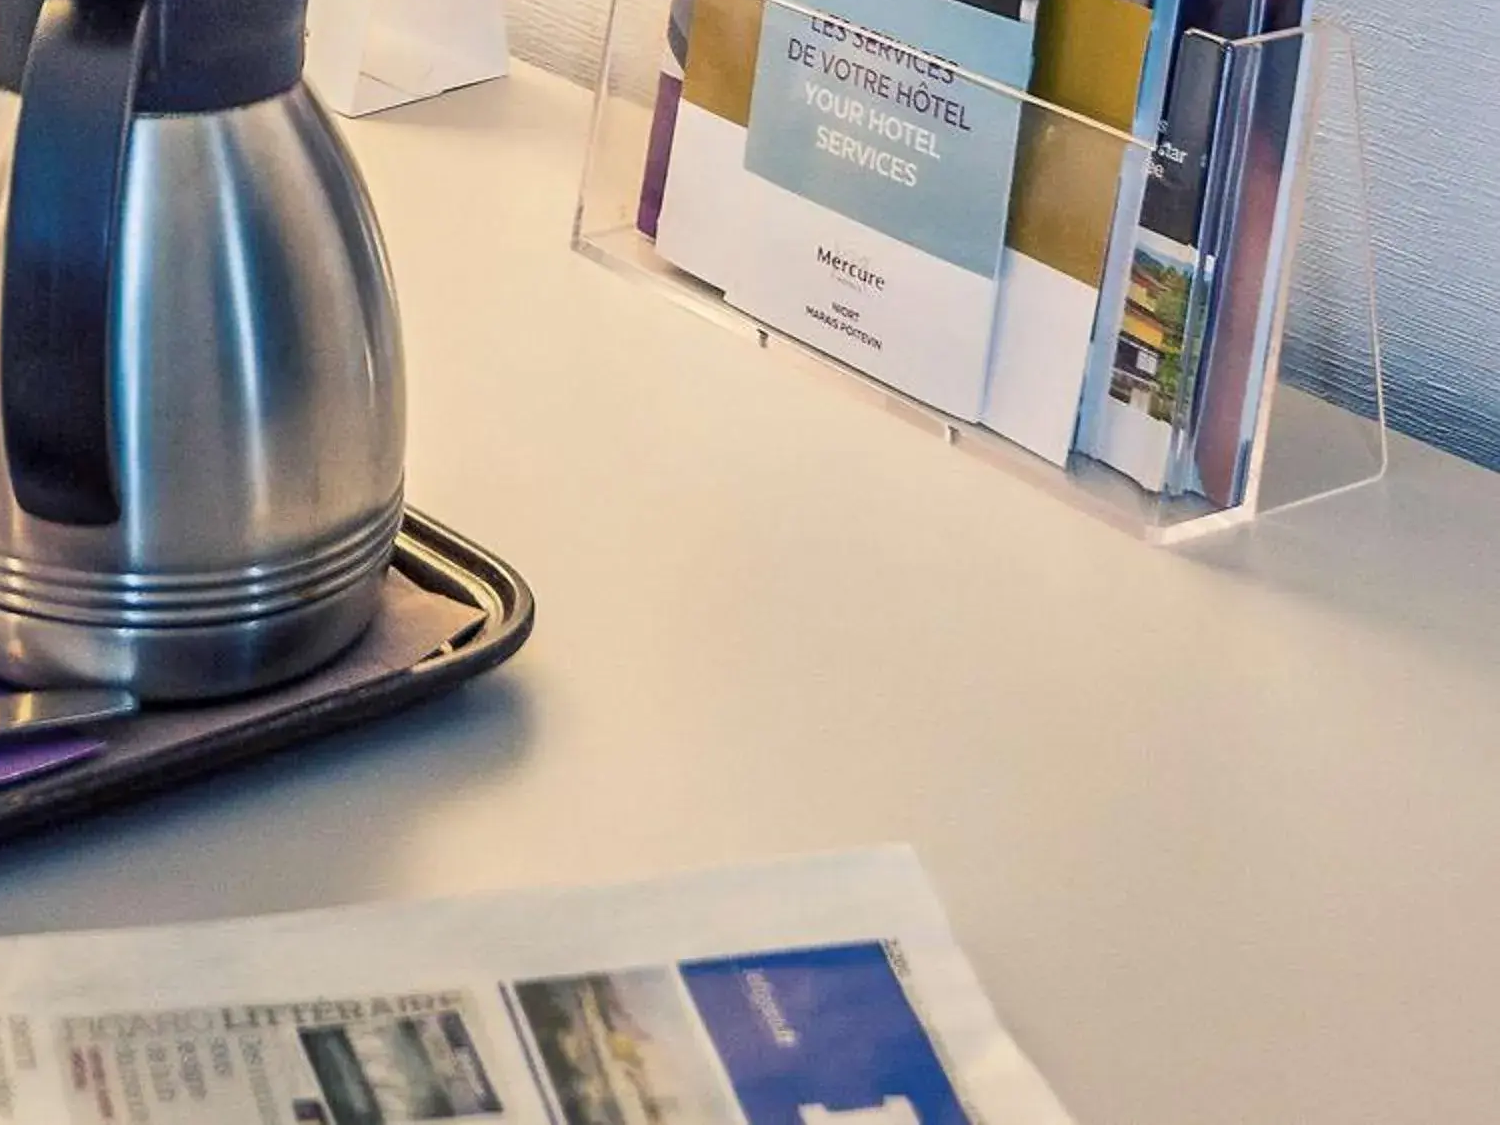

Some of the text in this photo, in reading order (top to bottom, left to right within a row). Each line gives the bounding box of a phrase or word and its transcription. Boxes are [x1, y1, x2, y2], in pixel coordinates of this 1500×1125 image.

[787, 38, 972, 131] DE VOTRE HÔTEL
[811, 14, 959, 85] LES SERVICES
[804, 81, 941, 160] YOUR HOTEL
[815, 125, 918, 188] SERVICES
[816, 245, 885, 292] Mercure
